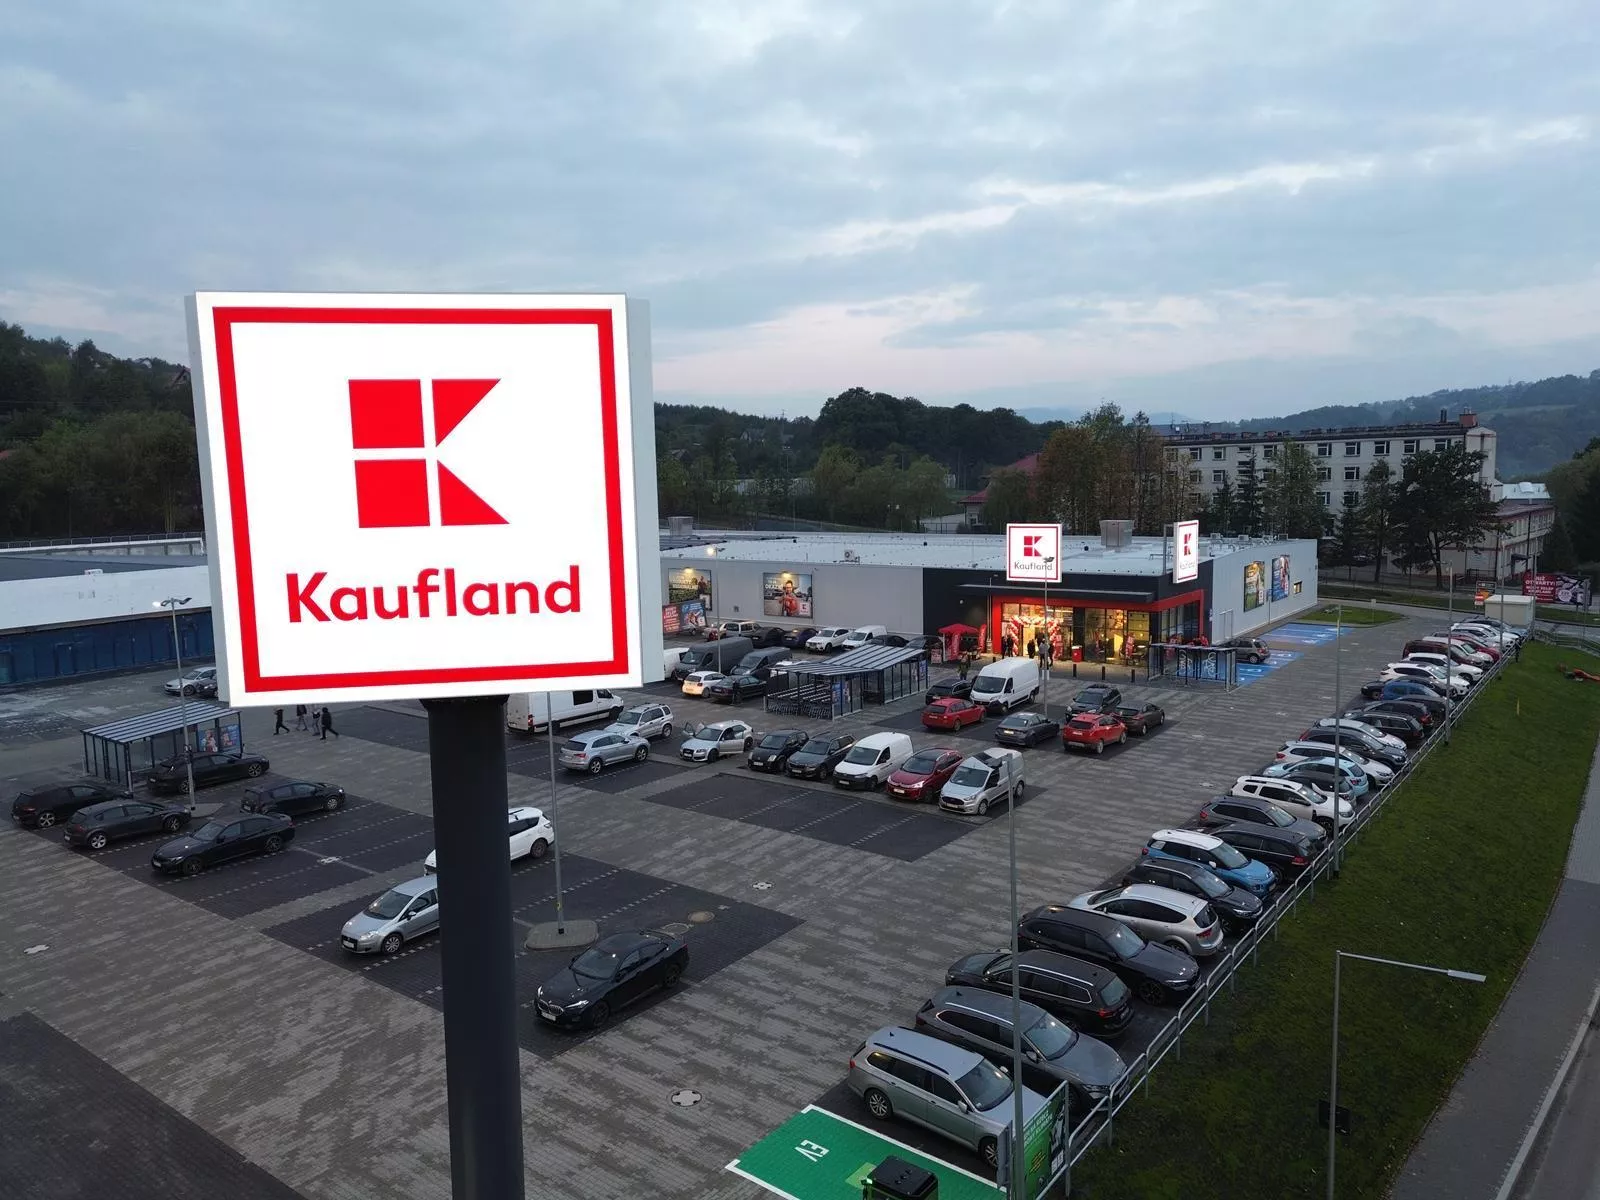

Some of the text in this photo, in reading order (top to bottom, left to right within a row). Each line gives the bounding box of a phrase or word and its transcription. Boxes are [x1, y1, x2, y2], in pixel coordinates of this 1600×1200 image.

[1013, 561, 1053, 571] Kaufland
[286, 564, 582, 624] Kaufland
[794, 1139, 830, 1162] EV
